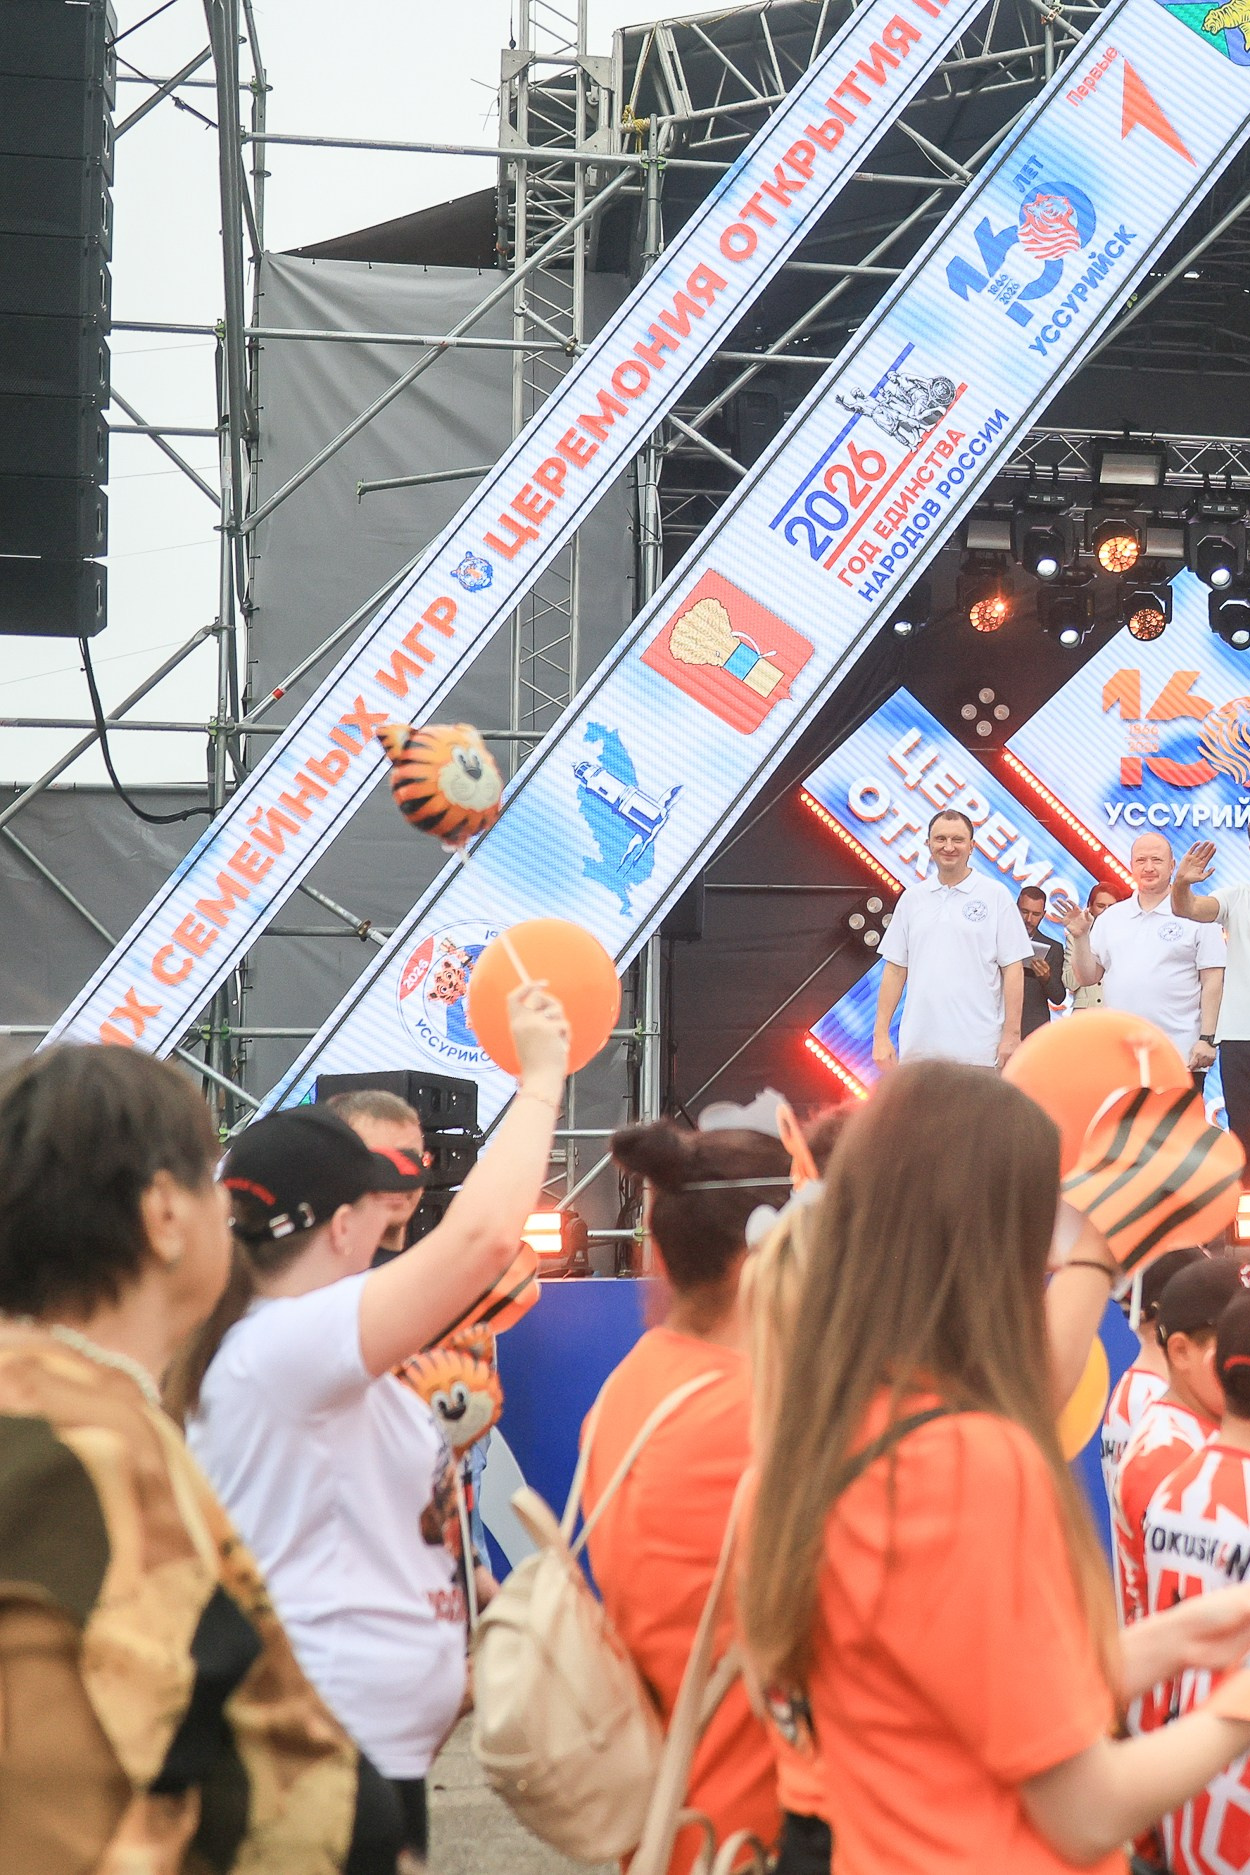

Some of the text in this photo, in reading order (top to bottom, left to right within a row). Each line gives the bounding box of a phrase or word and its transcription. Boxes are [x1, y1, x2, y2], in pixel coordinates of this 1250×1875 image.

[1065, 47, 1118, 107] Первые
[1012, 154, 1043, 193] ЛЕТ
[482, 14, 922, 561] ЦЕРЕМОНИЯ ОТКРЫТИЯ
[987, 273, 1009, 295] 1866
[999, 282, 1020, 305] 2026
[1028, 224, 1137, 357] УССУРИЙСК
[784, 441, 887, 561] 2026
[837, 428, 966, 588] ГОД ЕДИНСТВА
[858, 408, 1010, 602] НАРОДОВ РОССИИ
[150, 596, 458, 987] СЕМЕЙНЫХ ИГР
